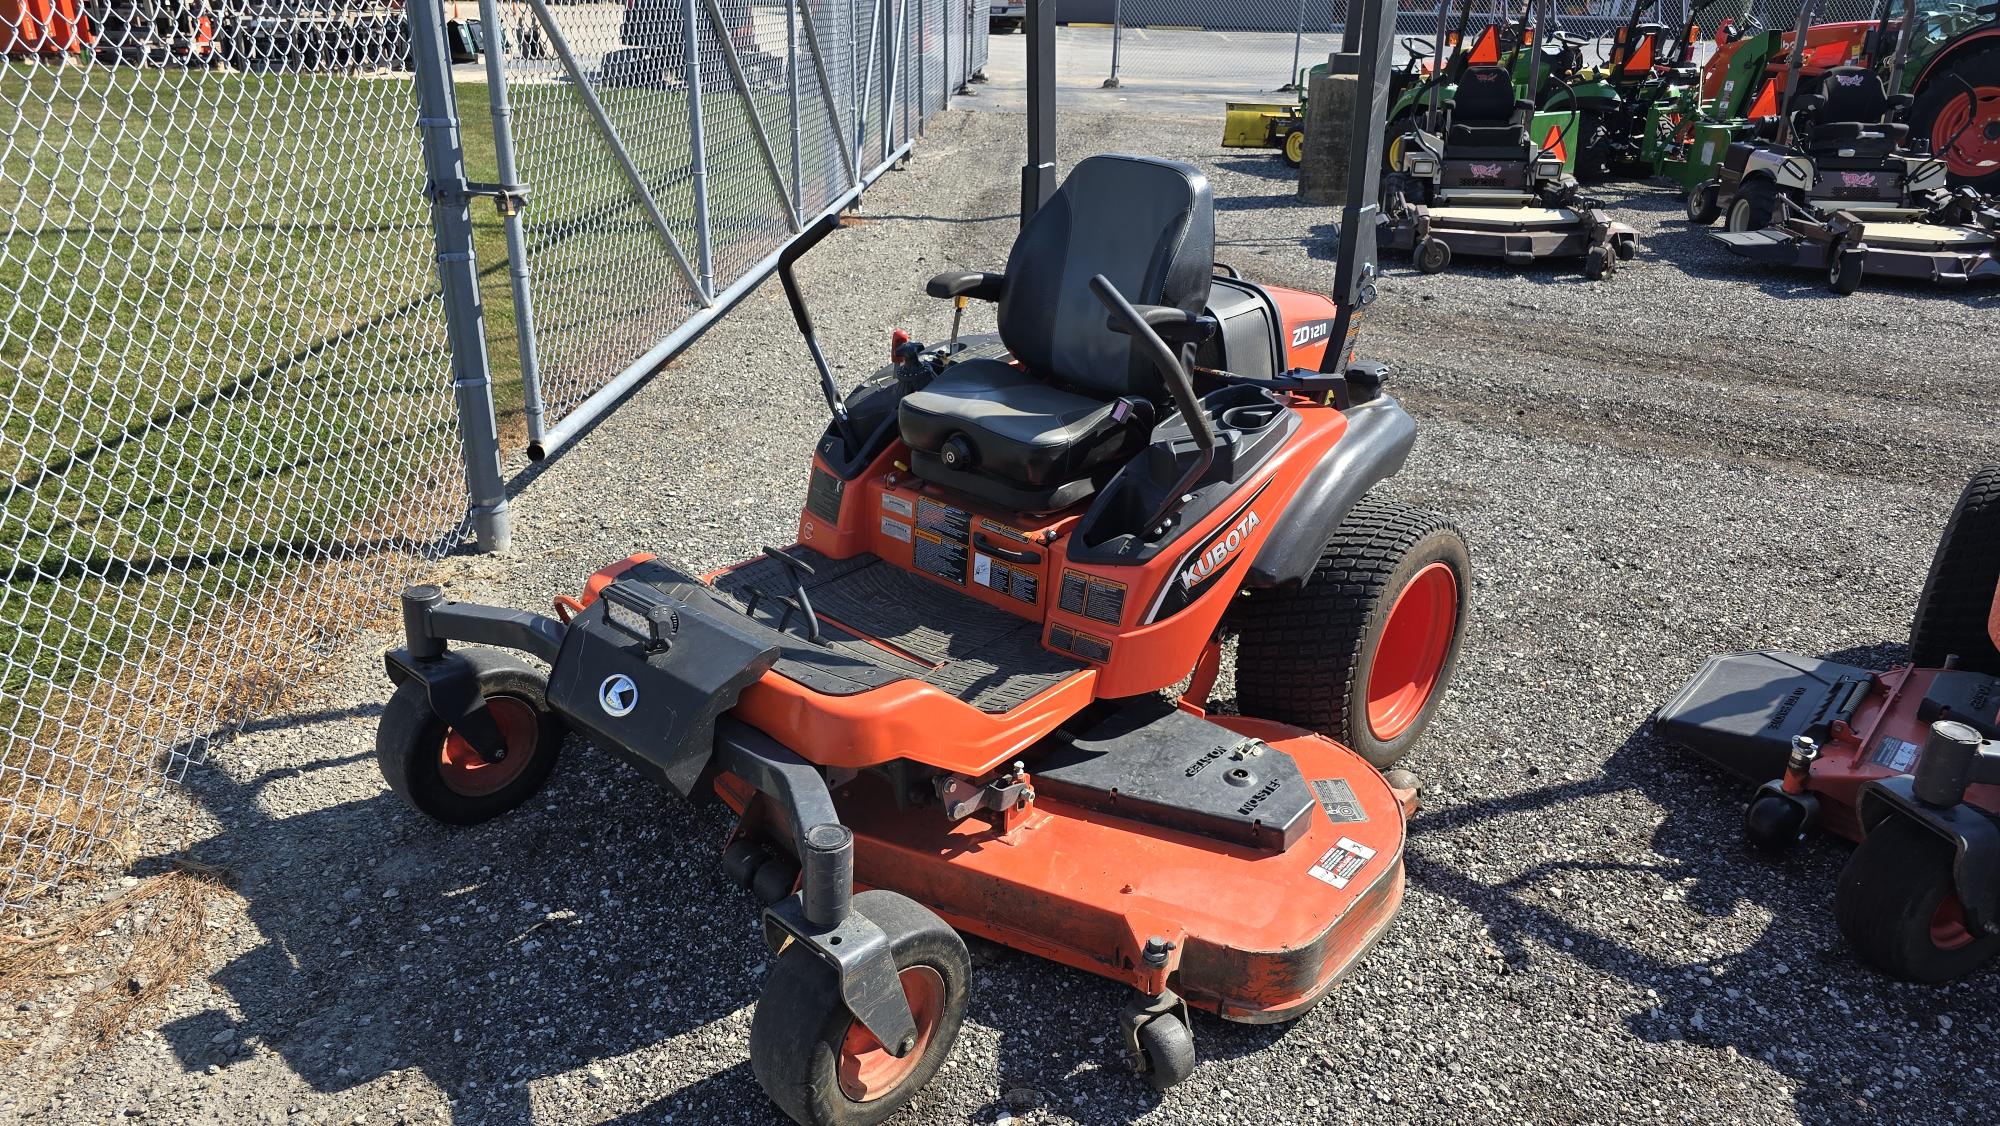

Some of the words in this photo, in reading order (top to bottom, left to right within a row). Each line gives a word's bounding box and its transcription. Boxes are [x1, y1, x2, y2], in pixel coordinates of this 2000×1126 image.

[1292, 325, 1310, 348] ZD
[1310, 322, 1327, 339] 1211
[1181, 510, 1260, 589] KUBOTA
